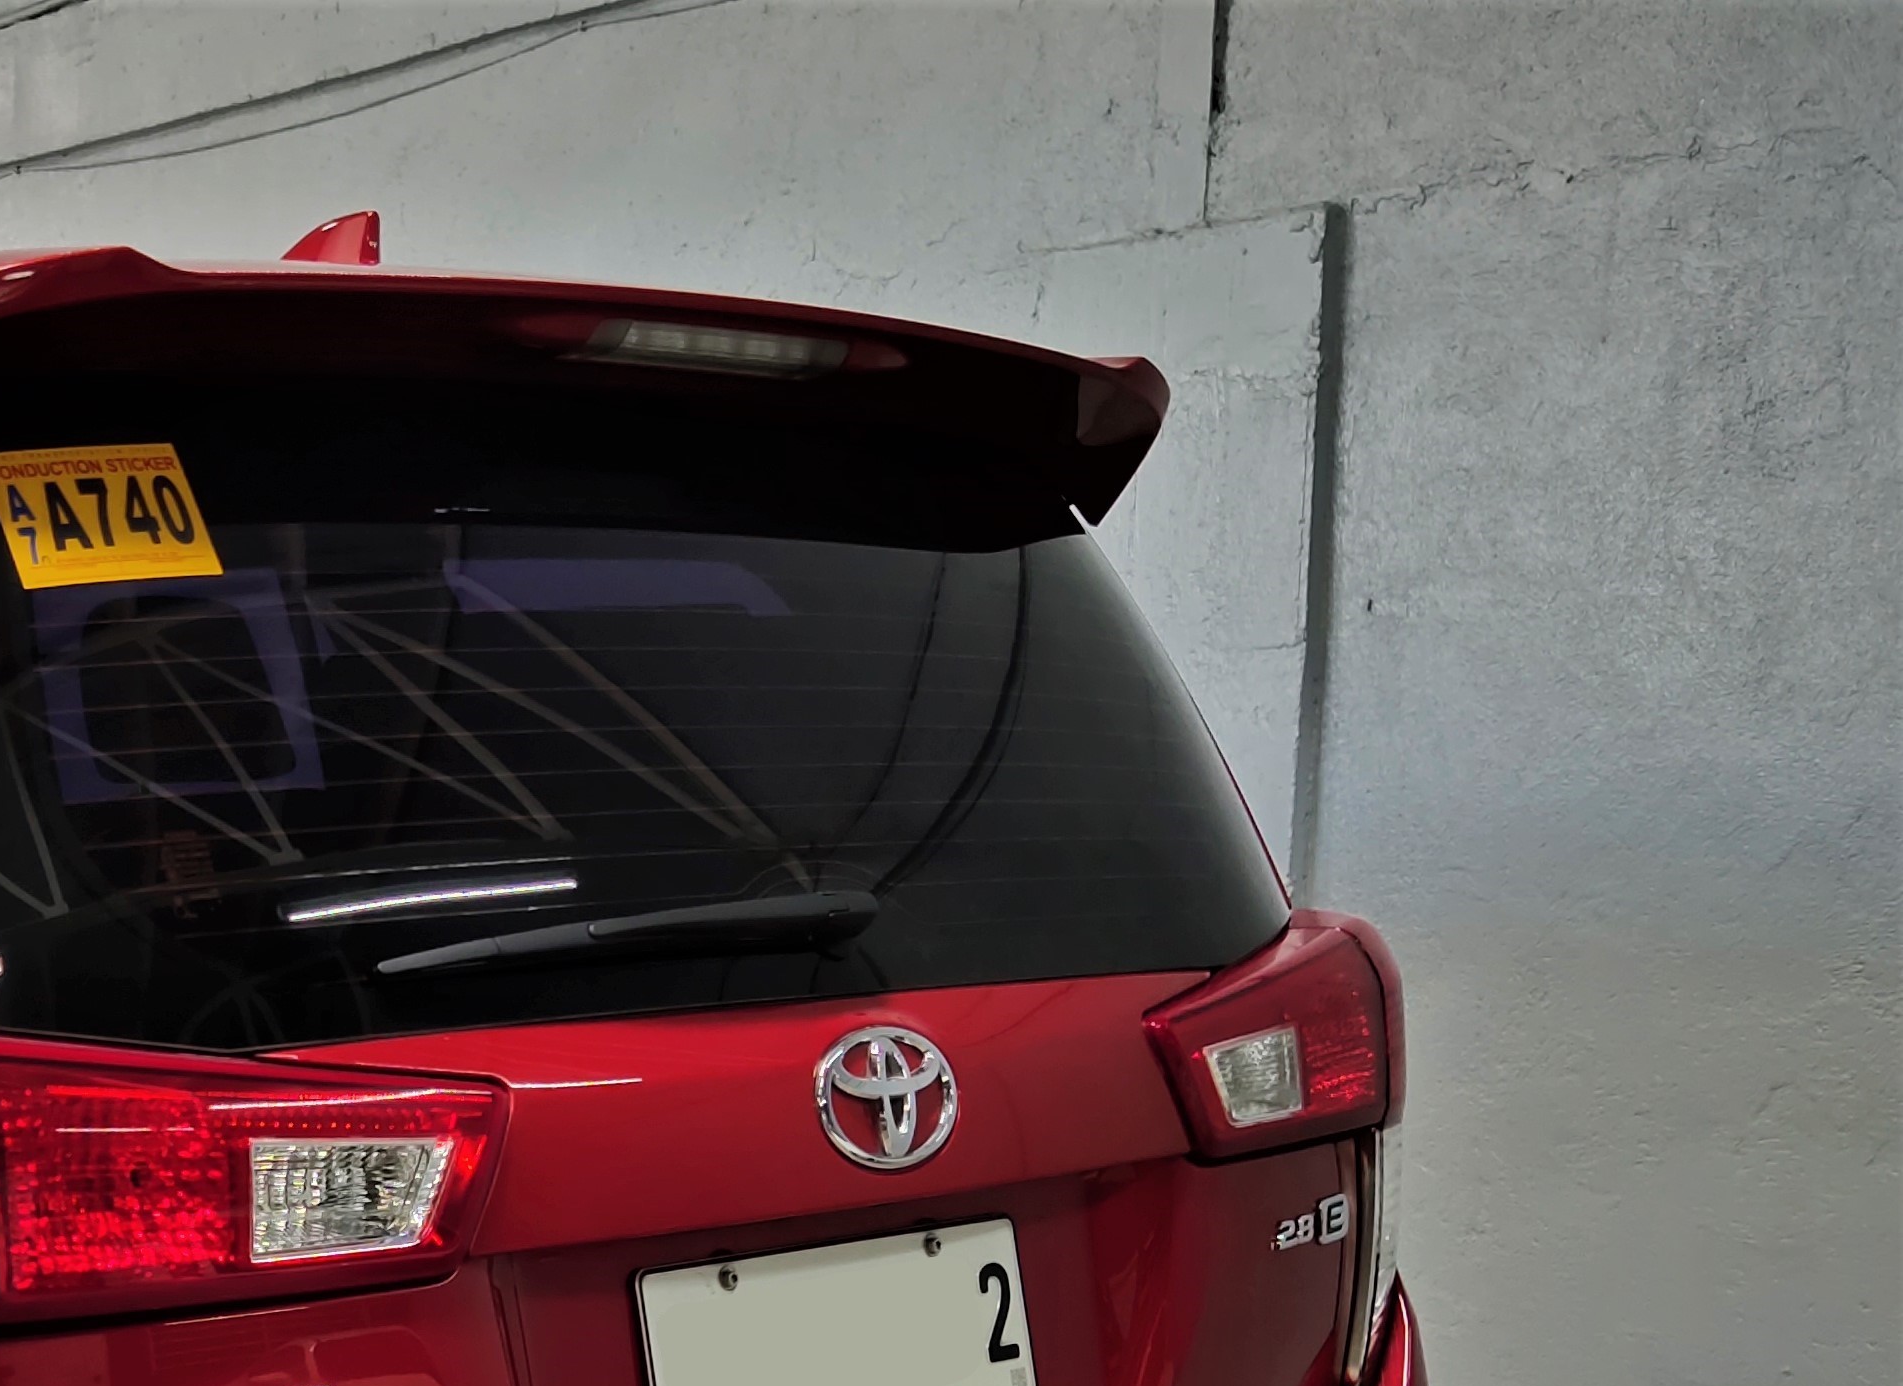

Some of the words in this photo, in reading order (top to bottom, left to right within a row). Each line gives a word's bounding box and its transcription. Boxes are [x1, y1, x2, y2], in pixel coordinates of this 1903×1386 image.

[105, 456, 177, 473] STICKER
[7, 484, 35, 522] A
[43, 475, 195, 551] A740
[18, 527, 39, 565] 7
[1319, 1193, 1350, 1245] E
[978, 1262, 1020, 1363] 2
